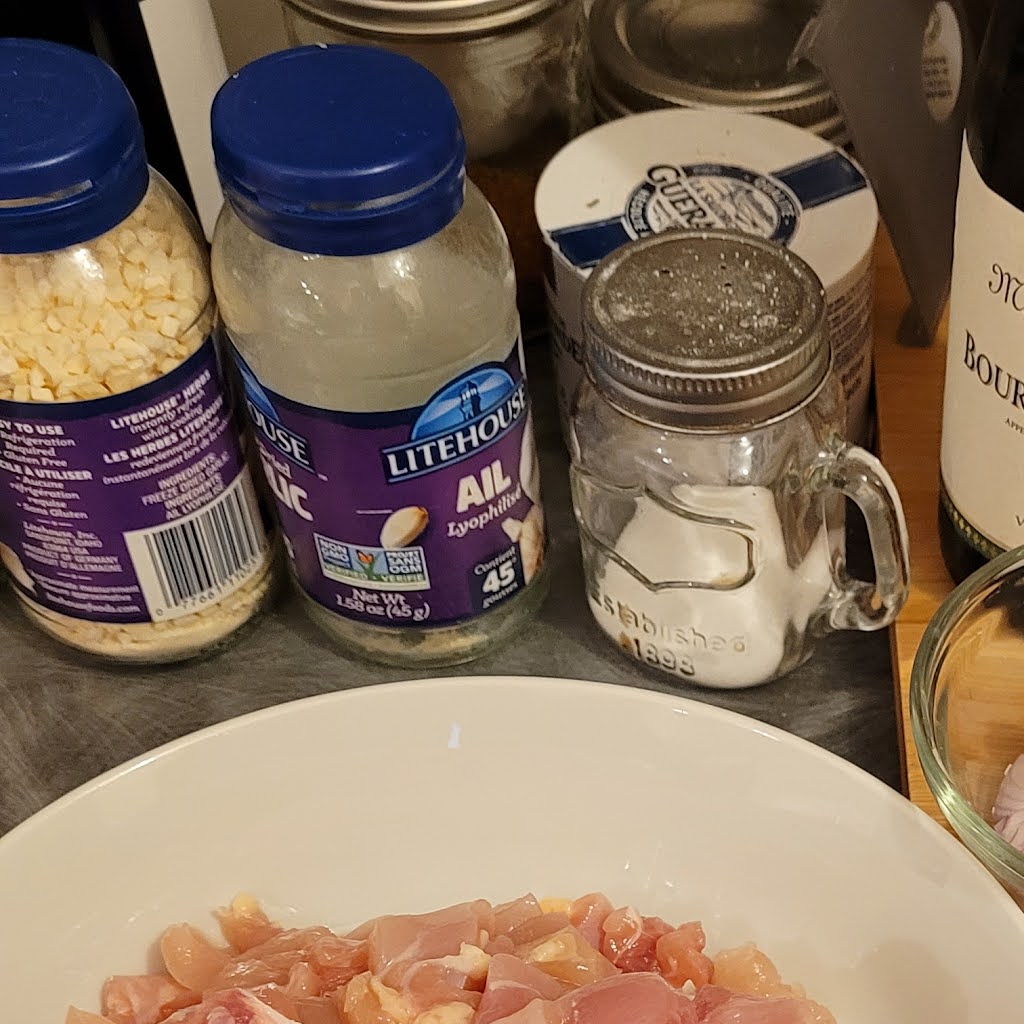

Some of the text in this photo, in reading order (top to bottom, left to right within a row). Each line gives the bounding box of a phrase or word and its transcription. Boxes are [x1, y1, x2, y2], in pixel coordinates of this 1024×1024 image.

[14, 422, 34, 434] TO
[35, 425, 65, 436] USE
[387, 384, 527, 477] LITEHOUSE
[103, 450, 130, 464] LES
[456, 459, 512, 514] AIL
[320, 540, 348, 555] NON
[388, 565, 423, 574] OGM
[352, 588, 406, 606] Net Wt
